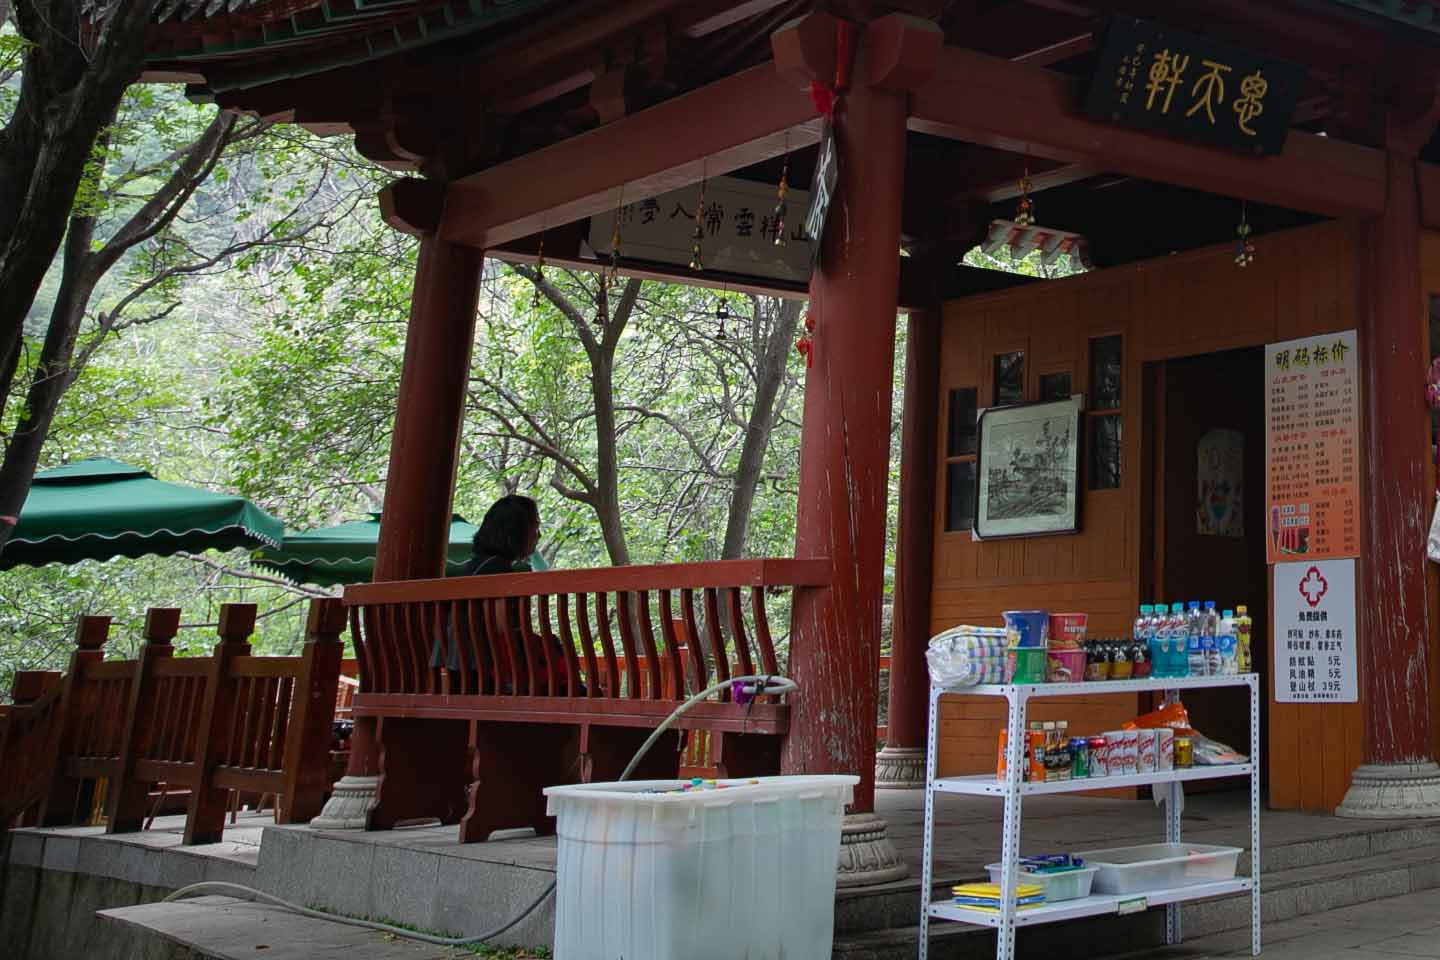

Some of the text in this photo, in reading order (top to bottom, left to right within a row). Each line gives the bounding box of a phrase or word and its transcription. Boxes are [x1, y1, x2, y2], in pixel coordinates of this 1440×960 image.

[1274, 338, 1350, 369] 明码标价
[1289, 668, 1315, 679] 风油精
